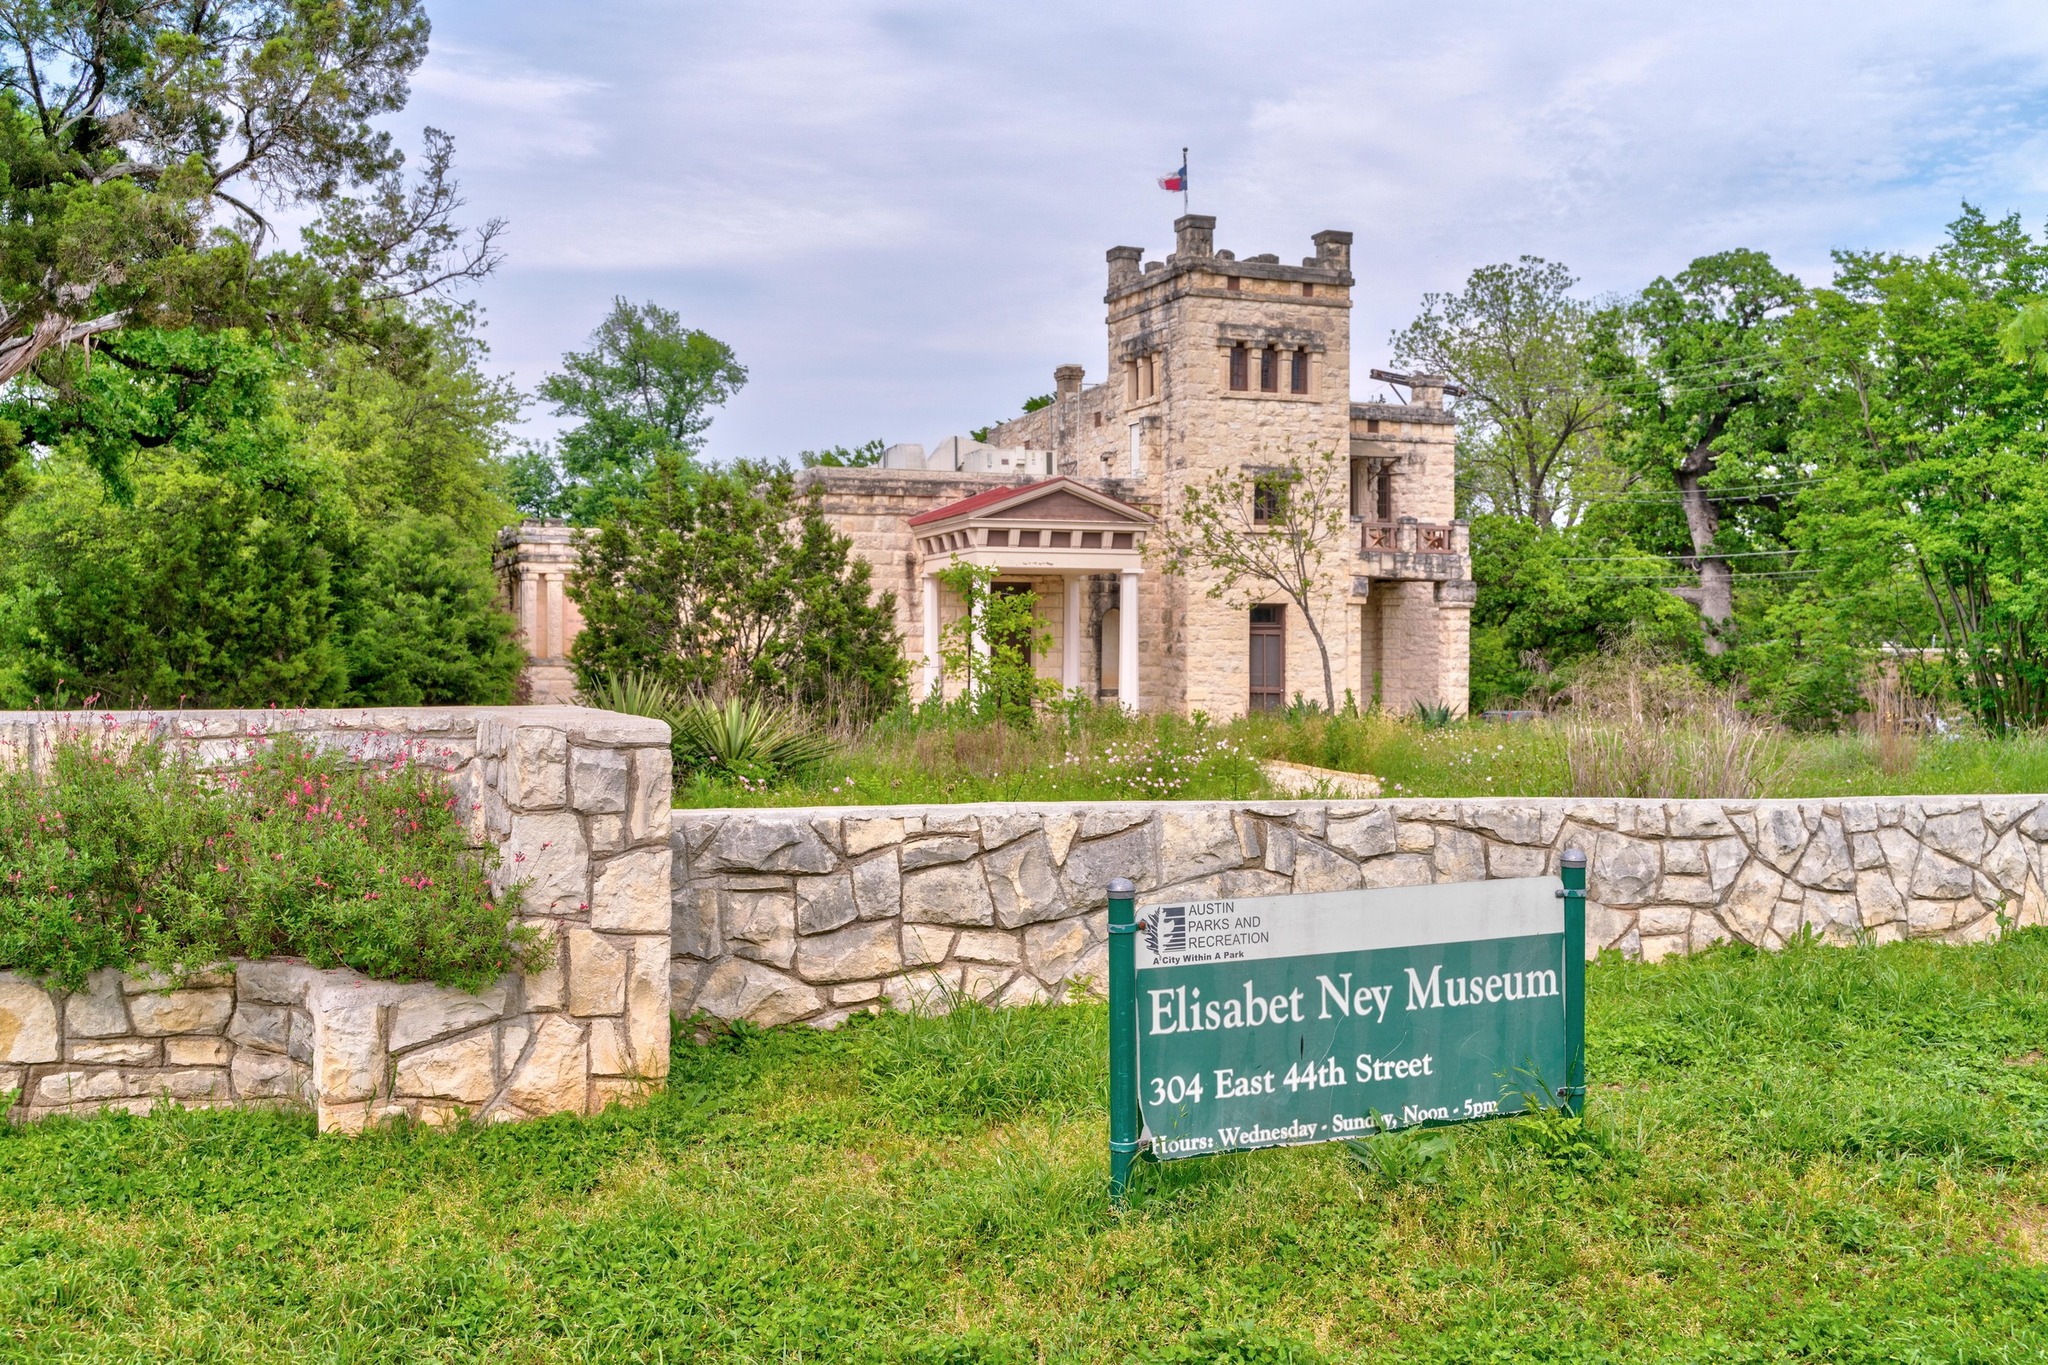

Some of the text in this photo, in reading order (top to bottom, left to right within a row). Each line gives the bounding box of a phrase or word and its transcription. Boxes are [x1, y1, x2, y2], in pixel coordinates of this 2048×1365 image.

[1188, 901, 1235, 916] AUSTIN
[1188, 916, 1261, 932] PARKS AND
[1188, 932, 1269, 949] RECREATION
[1153, 950, 1244, 965] A City Within A Park
[1148, 965, 1559, 1036] Elisabet Ney Museum
[1149, 1052, 1433, 1106] 304 East 44th Street
[1150, 1135, 1214, 1155] Hours:
[1218, 1119, 1318, 1146] Wednesday
[1332, 1113, 1397, 1133] Sundy,
[1404, 1104, 1449, 1124] Noon
[1464, 1098, 1499, 1117] 5pm
